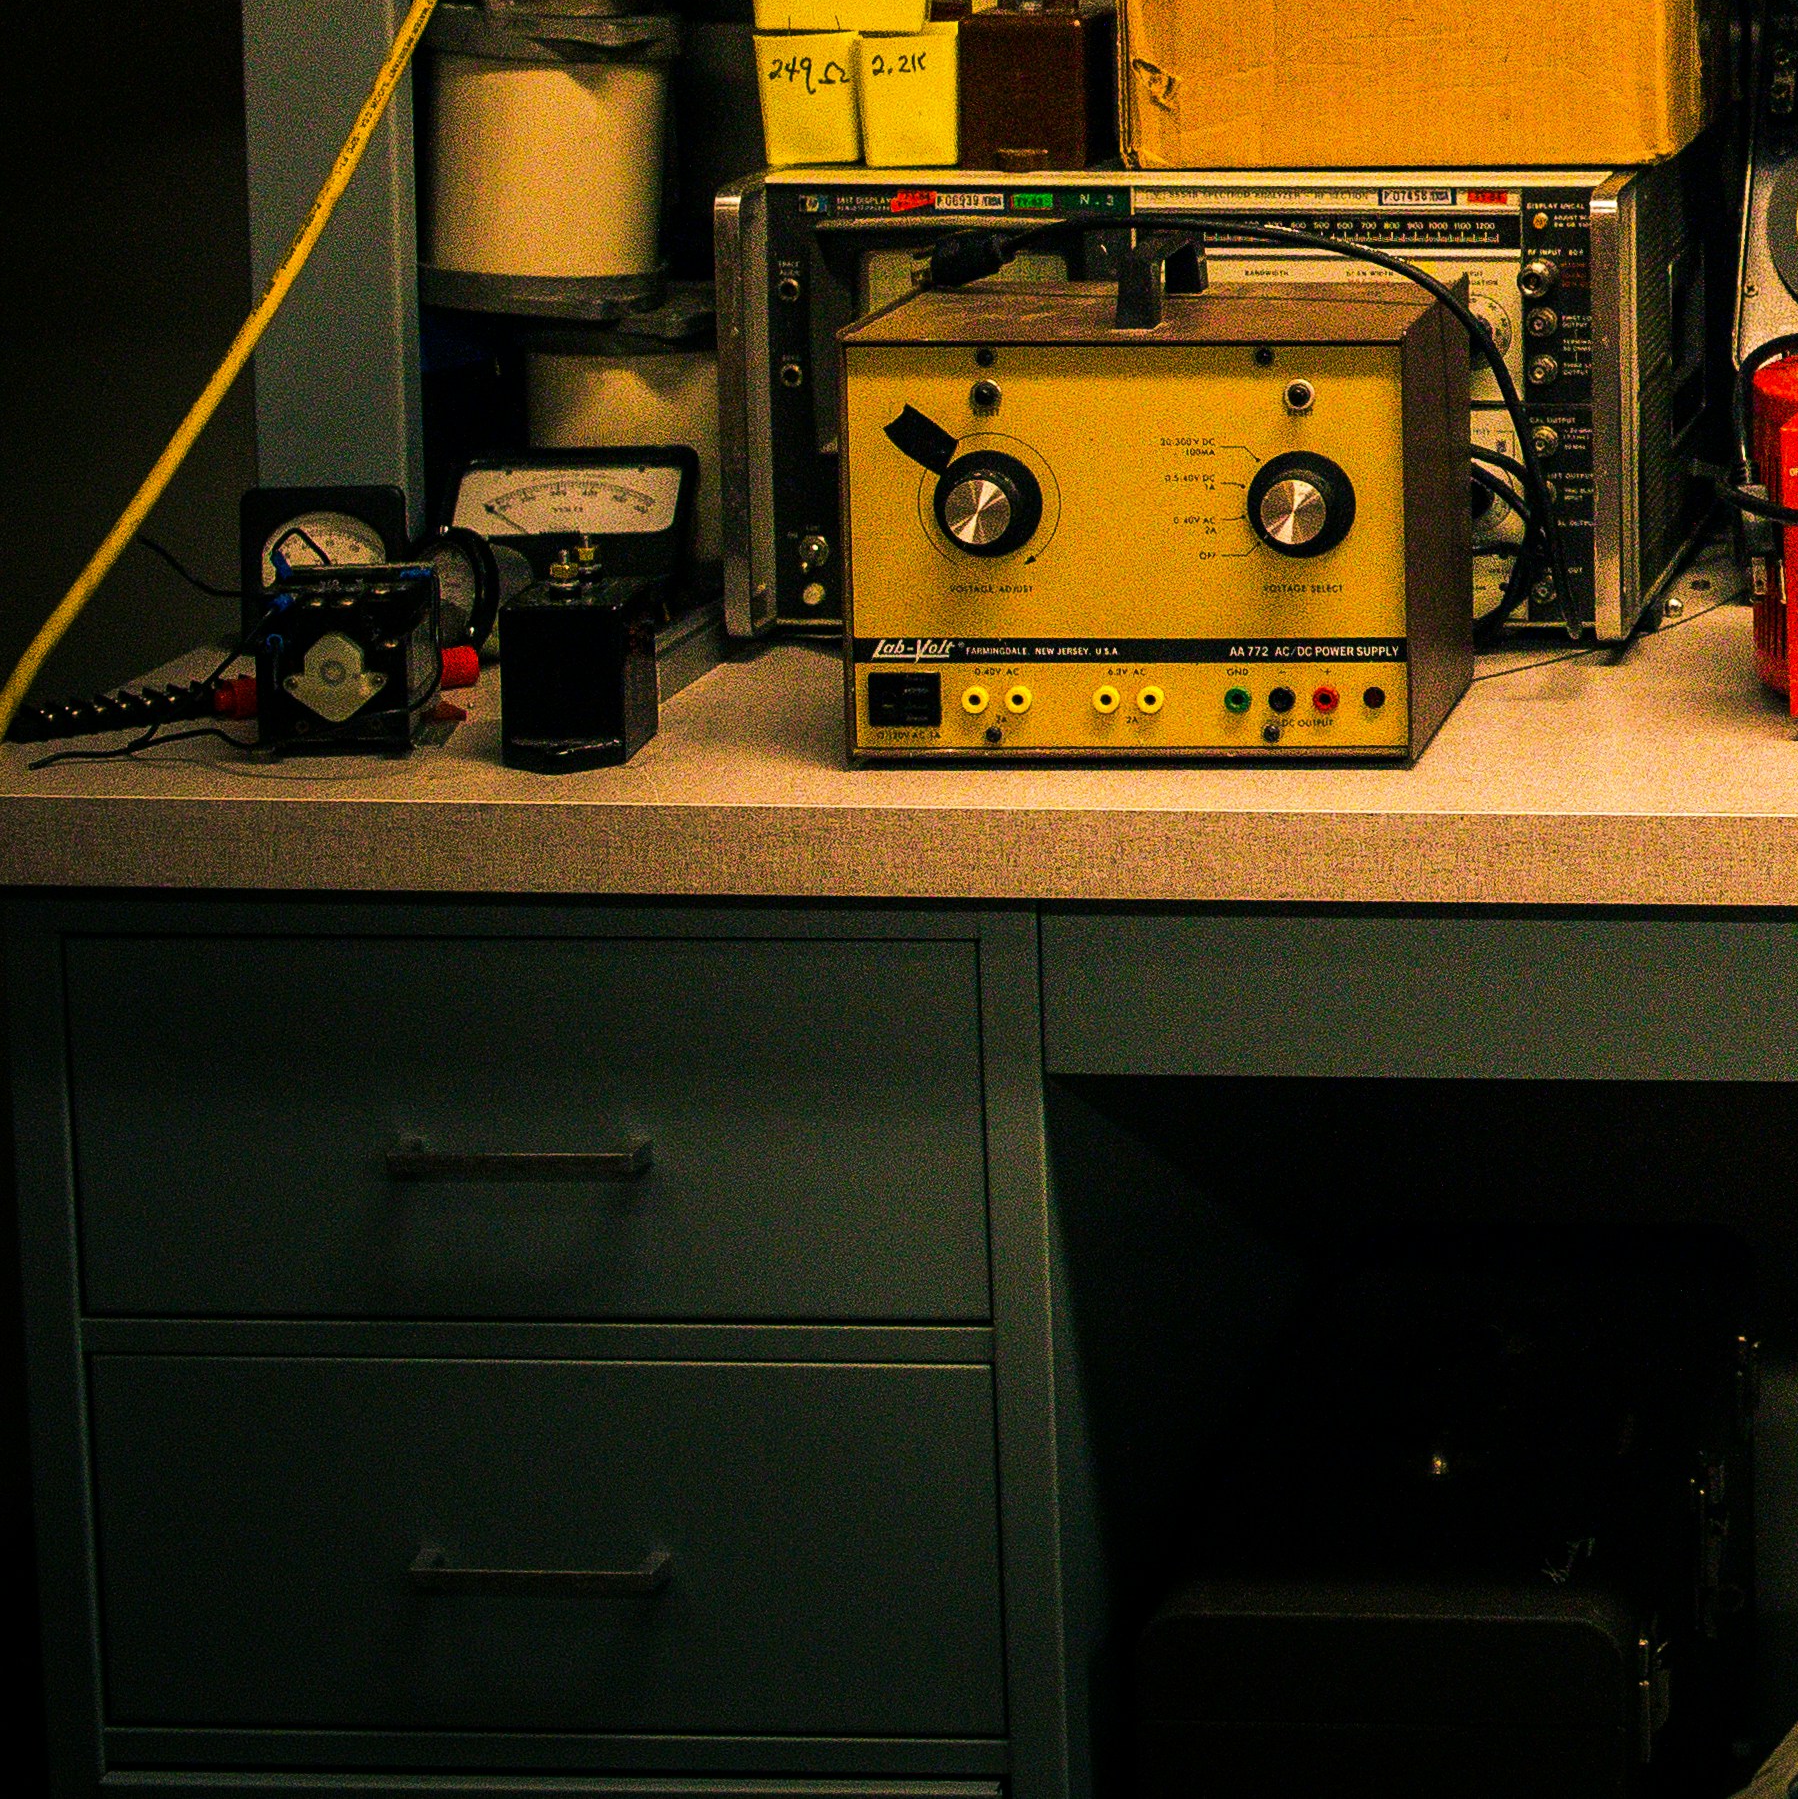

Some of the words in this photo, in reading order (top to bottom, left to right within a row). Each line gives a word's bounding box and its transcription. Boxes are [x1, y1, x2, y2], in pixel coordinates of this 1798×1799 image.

[1313, 220, 1331, 230] 500
[1336, 220, 1354, 230] 600
[1360, 220, 1377, 230] 700
[1383, 220, 1400, 230] 800
[1407, 220, 1424, 230] 900
[1428, 220, 1449, 230] 1000
[1453, 220, 1472, 230] 1100
[1475, 220, 1496, 230] 1200
[1244, 269, 1289, 277] BANDWIDTH
[950, 584, 994, 594] VOLTAGE
[998, 584, 1034, 594] ADJUST
[1263, 584, 1306, 594] VOLTAGE
[1310, 584, 1344, 593] SELECT
[871, 639, 955, 663] Lab-Volt
[1034, 646, 1055, 656] NEW
[1229, 645, 1245, 657] AA
[1247, 645, 1270, 657] 772
[1274, 645, 1313, 657] AC/DC
[1314, 645, 1355, 657] POWER
[1356, 645, 1400, 657] SUPPLY
[1005, 668, 1020, 677] AC
[1133, 668, 1147, 677] AC
[1226, 667, 1249, 677] GND
[1296, 718, 1333, 728] OUTPUT
